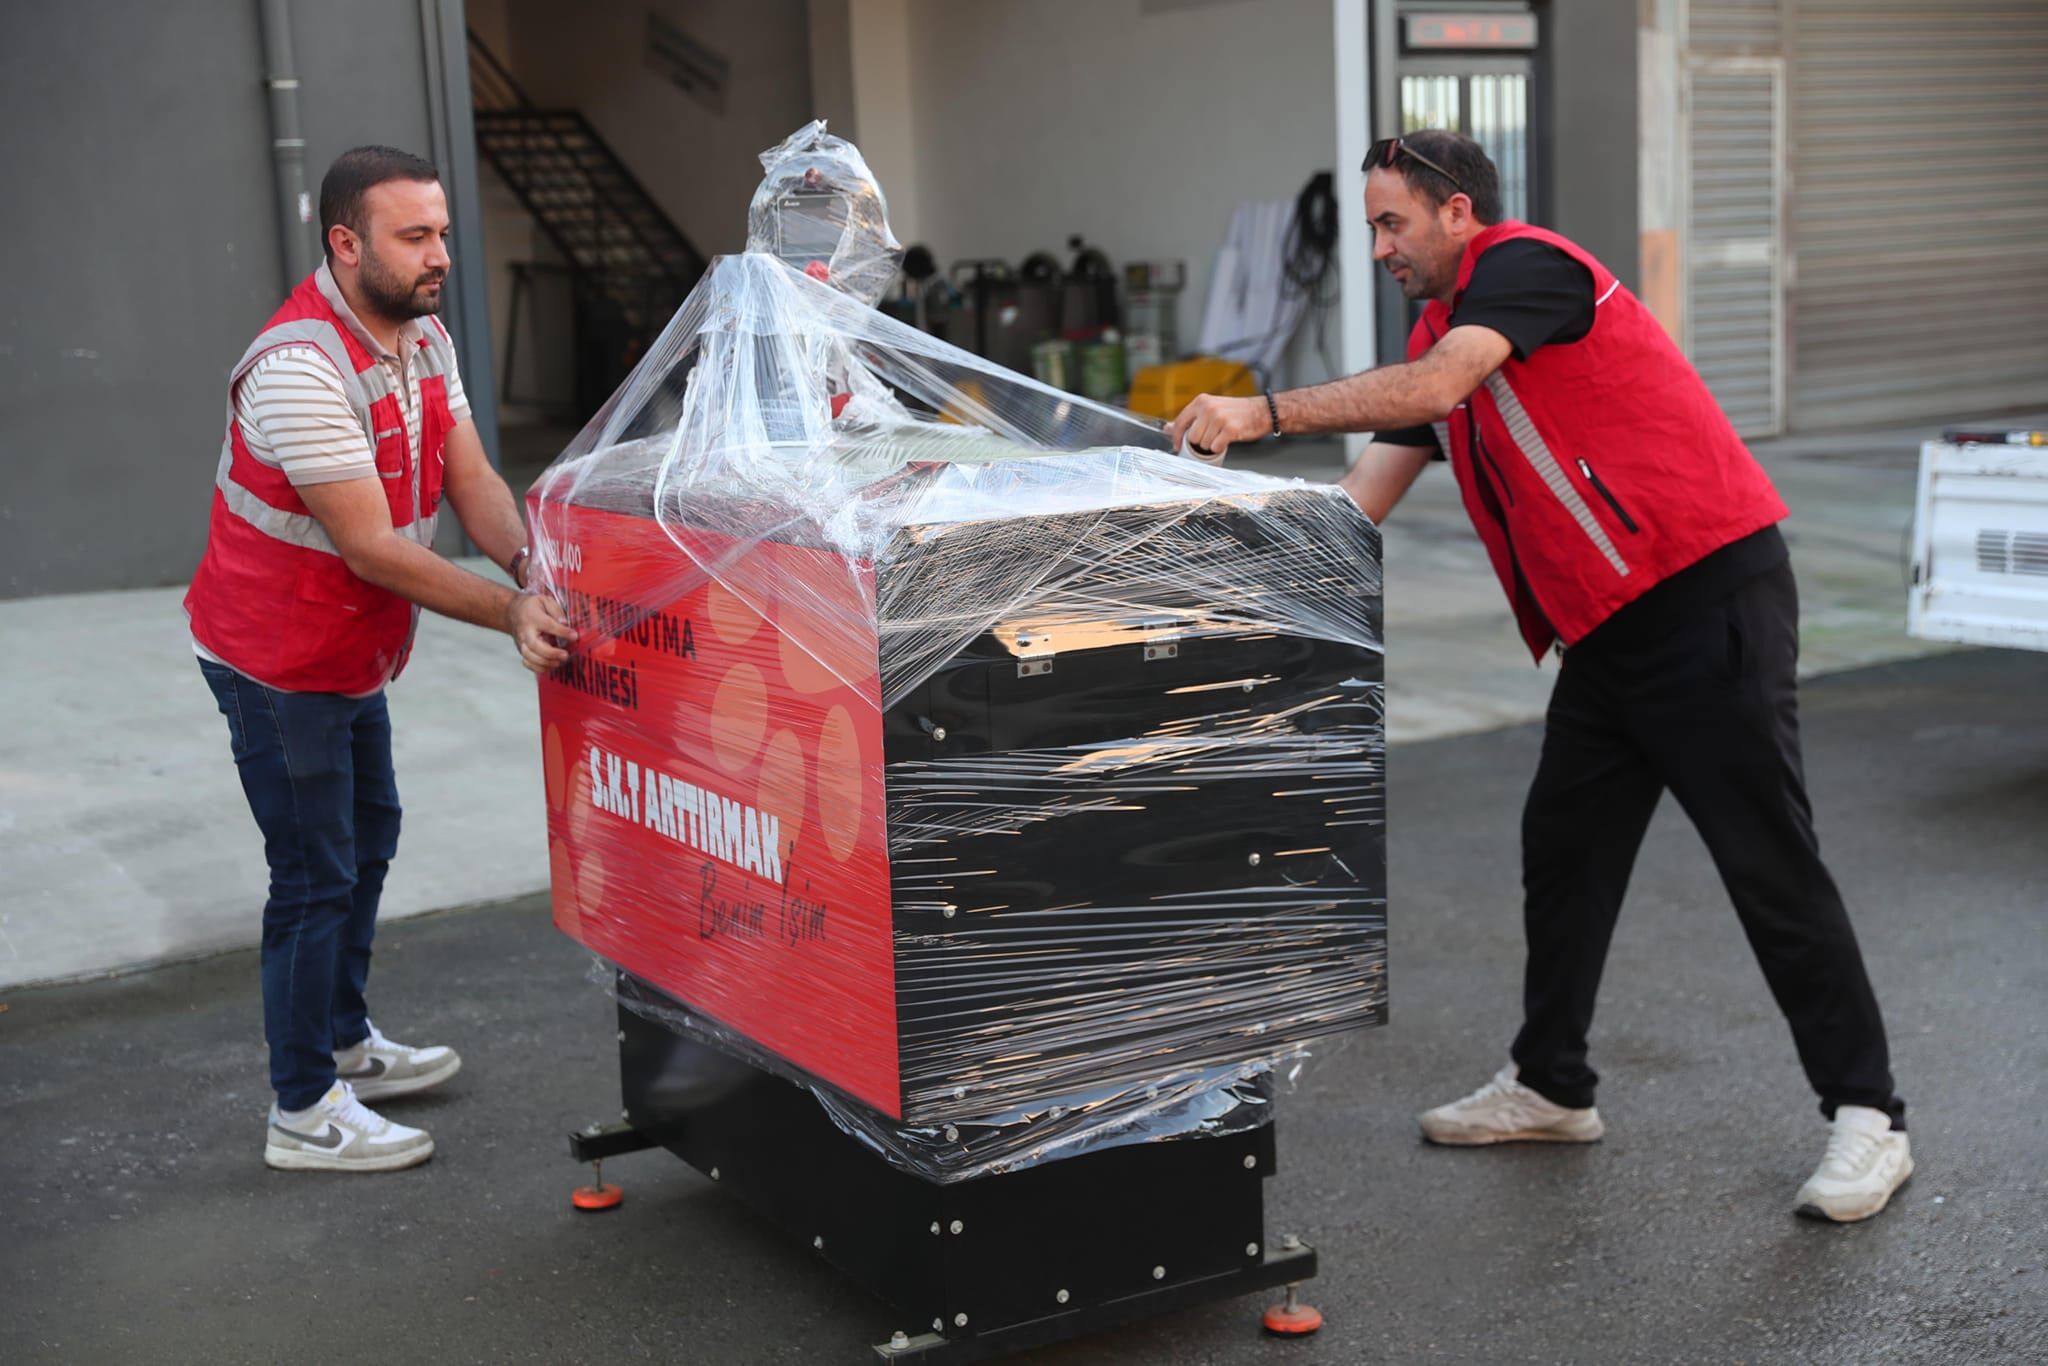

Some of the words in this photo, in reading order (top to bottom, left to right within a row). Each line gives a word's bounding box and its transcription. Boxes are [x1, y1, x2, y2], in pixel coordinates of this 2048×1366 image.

[596, 595, 698, 662] KURUTMA
[645, 767, 783, 885] ARTTIRMAK
[700, 860, 765, 939] Benim
